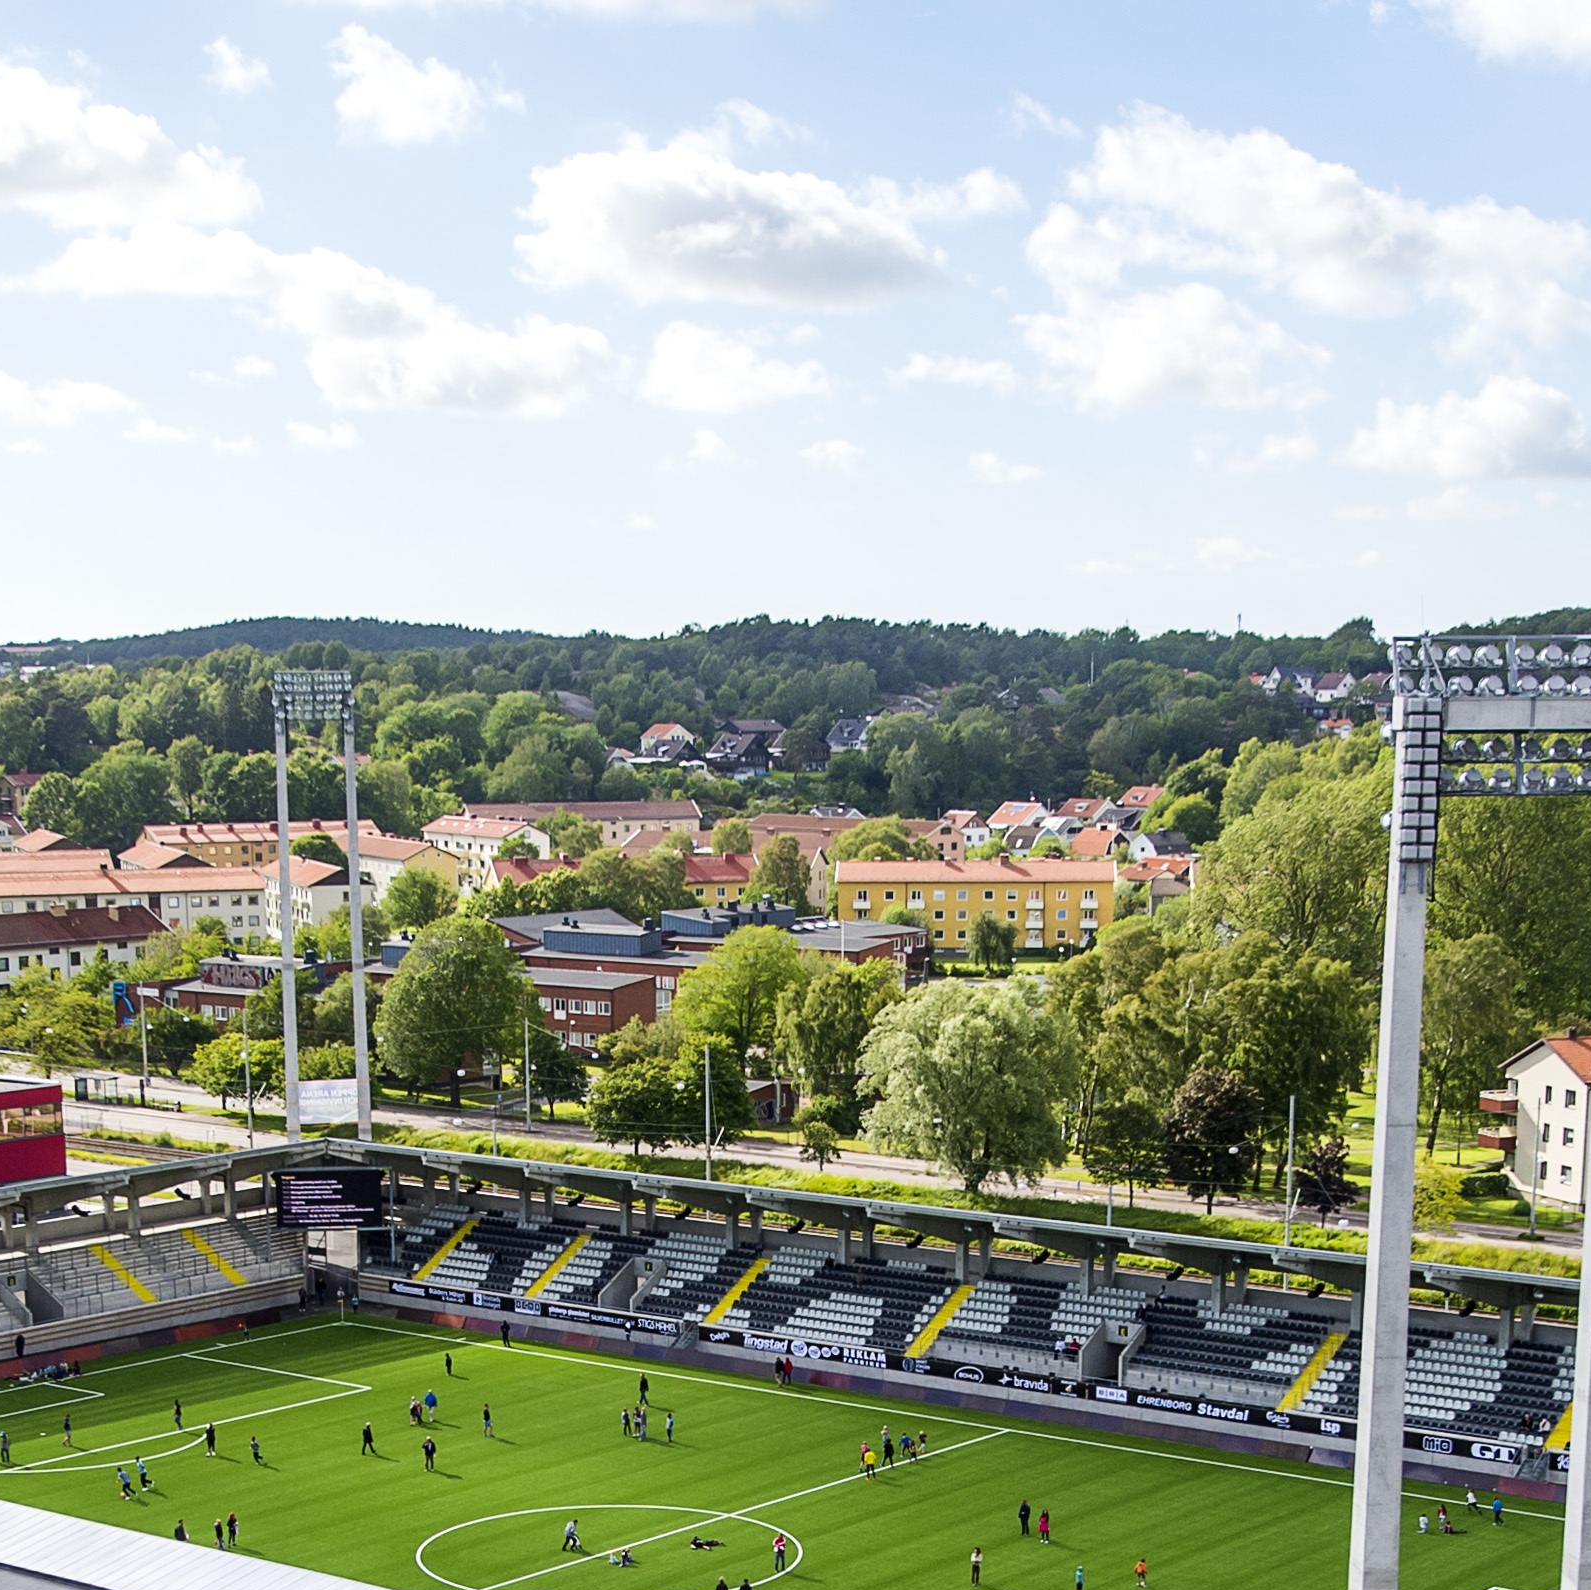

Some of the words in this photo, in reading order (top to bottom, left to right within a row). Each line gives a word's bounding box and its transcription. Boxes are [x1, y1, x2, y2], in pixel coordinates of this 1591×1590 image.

[743, 1333, 788, 1350] Tingstad
[843, 1348, 886, 1363] REKLAM
[1013, 1375, 1048, 1392] bravida
[1137, 1394, 1192, 1412] EHRENBORG
[1197, 1403, 1249, 1421] Stavdal
[1470, 1442, 1516, 1463] GT
